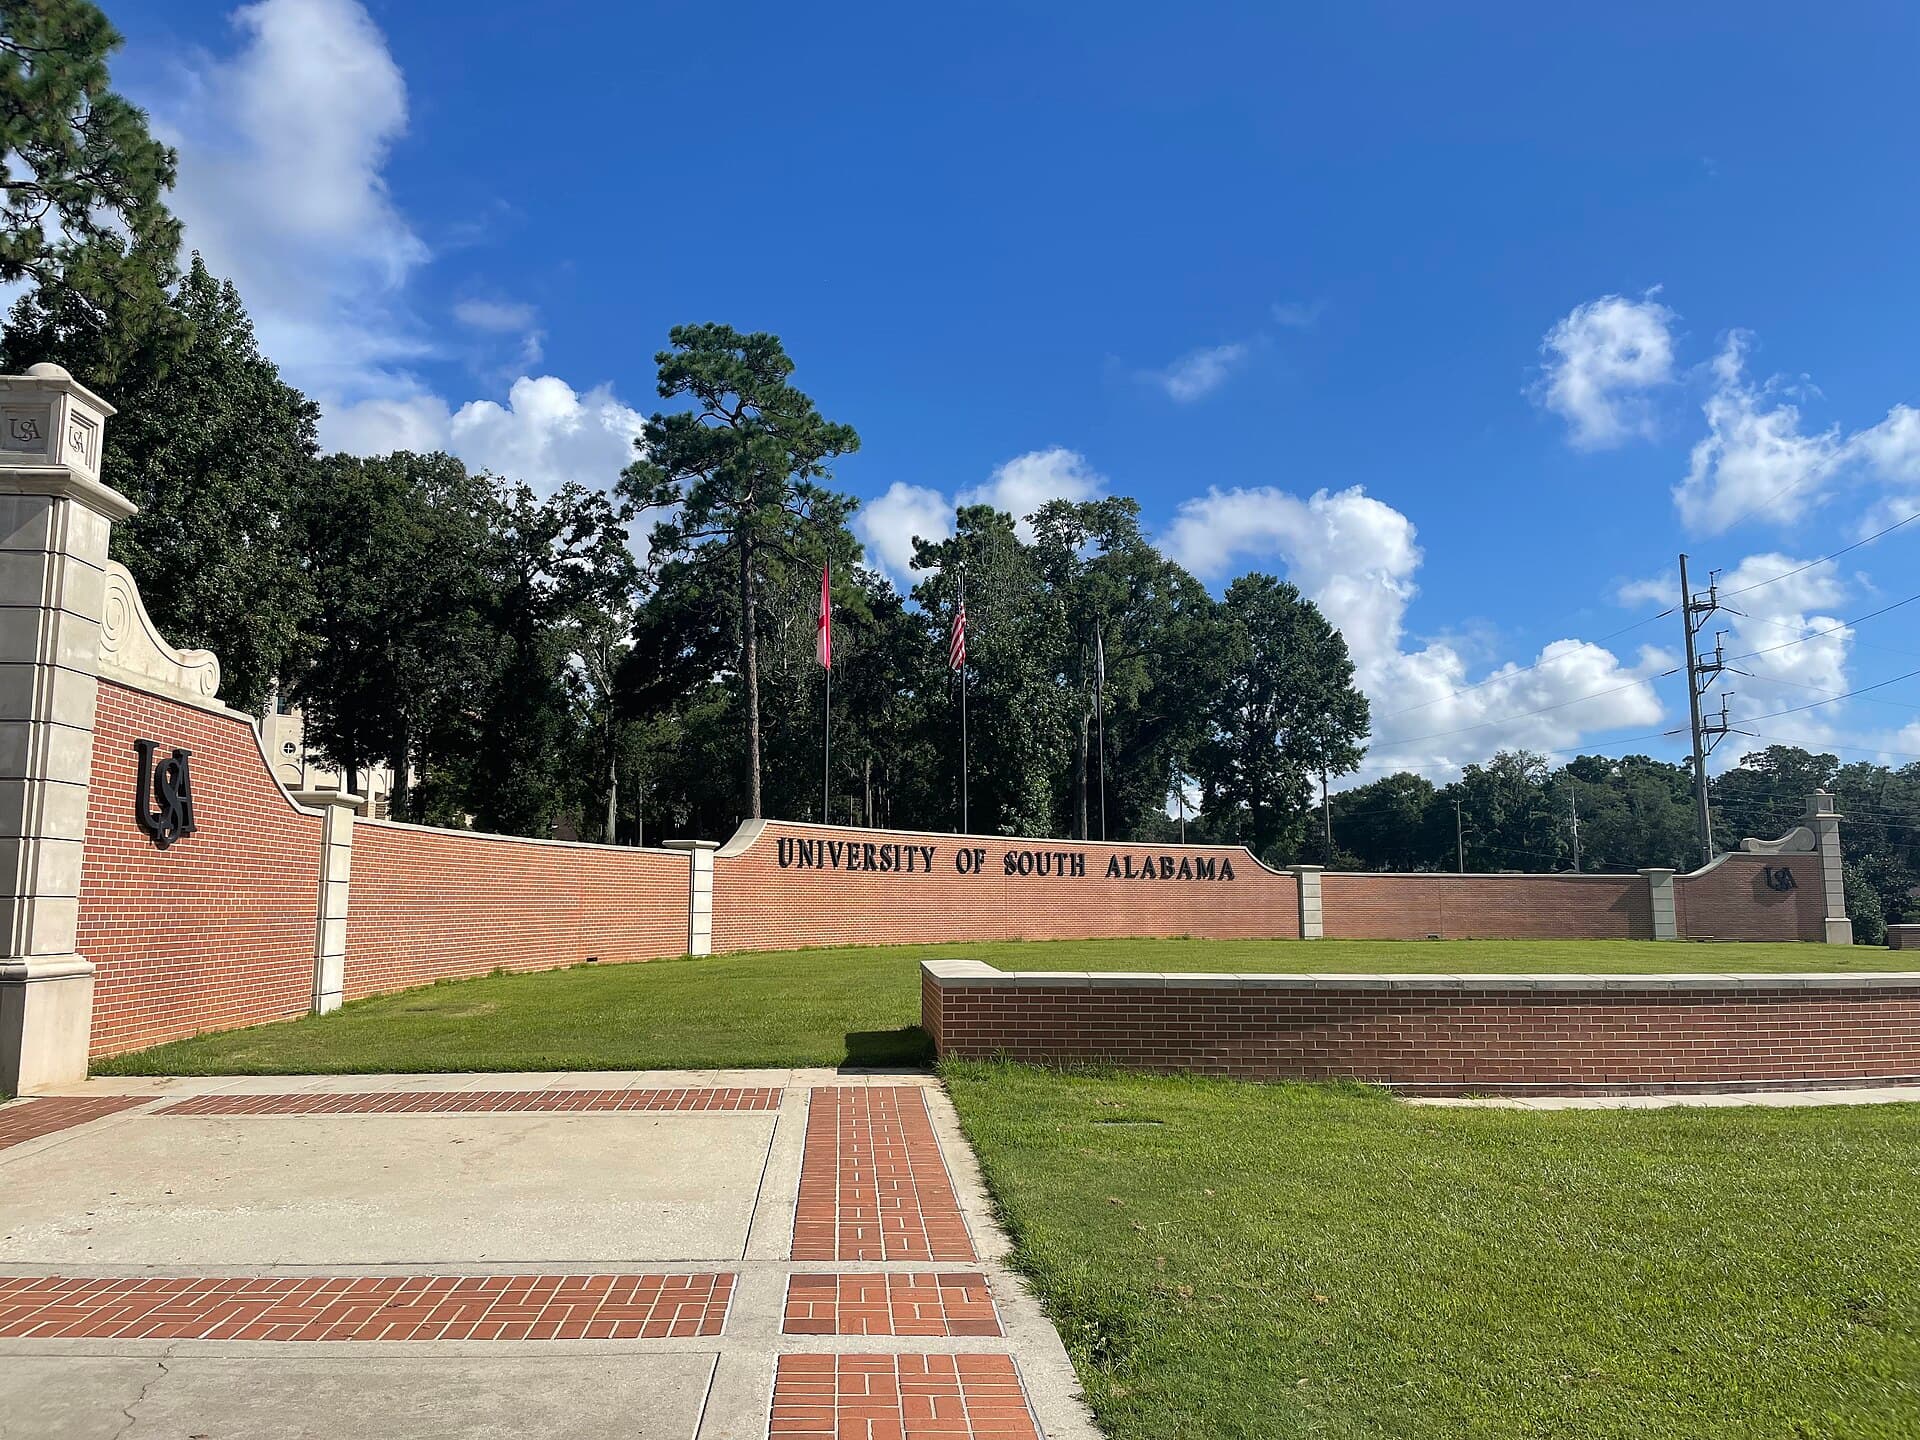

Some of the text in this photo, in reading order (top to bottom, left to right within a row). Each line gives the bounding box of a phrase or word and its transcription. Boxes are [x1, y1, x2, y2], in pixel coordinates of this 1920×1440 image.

[8, 418, 42, 442] USA
[68, 426, 85, 454] USA
[134, 738, 197, 850] USA
[777, 837, 1236, 881] UNIVERSITY OF SOUTH ALABAMA
